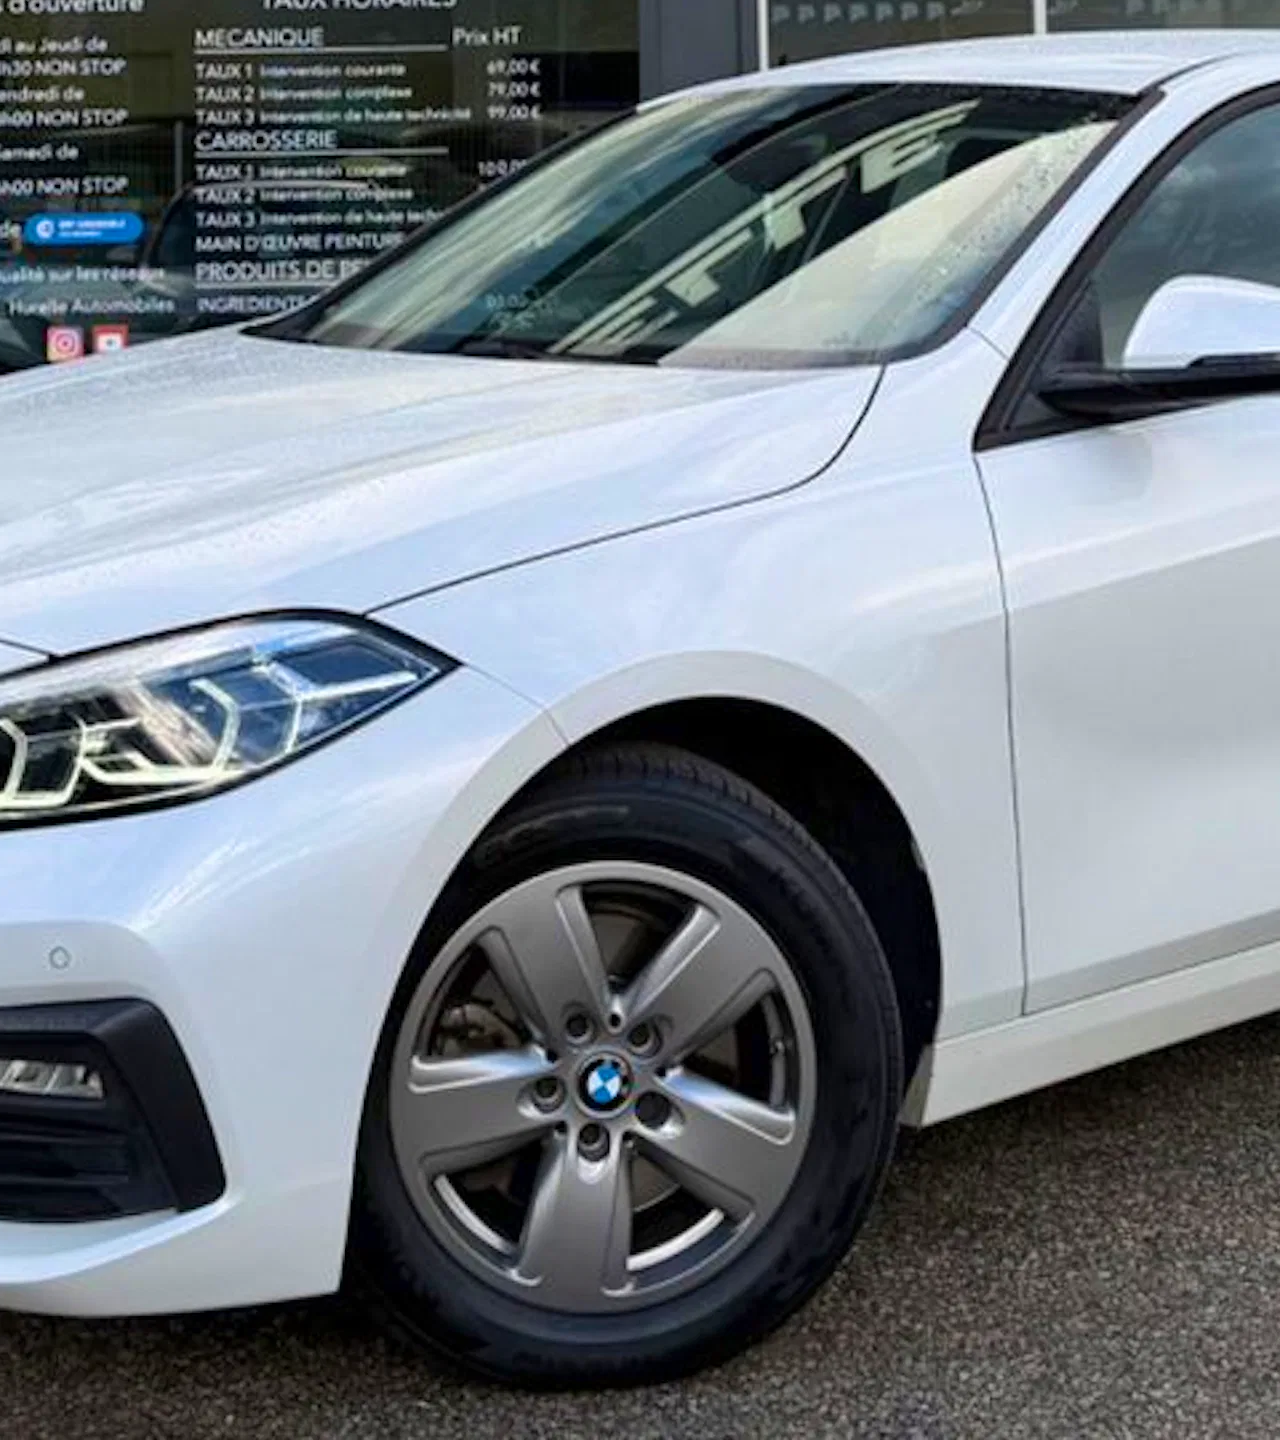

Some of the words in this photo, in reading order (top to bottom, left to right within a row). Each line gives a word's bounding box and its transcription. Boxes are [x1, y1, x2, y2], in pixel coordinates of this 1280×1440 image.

[15, 40, 35, 54] au
[85, 35, 108, 52] de
[194, 27, 324, 47] MECANIQUE
[453, 27, 489, 47] Prix
[493, 26, 523, 45] HT
[34, 58, 77, 76] NON
[79, 57, 127, 75] STOP
[195, 63, 242, 79] TAUX
[62, 85, 85, 102] de
[195, 86, 242, 103] TAUX
[243, 85, 255, 102] 2
[36, 109, 79, 127] NON
[81, 108, 129, 126] STOP
[195, 109, 242, 125] TAUX
[344, 109, 363, 122] de
[194, 129, 338, 151] CARROSSERIE
[55, 142, 79, 160] de
[195, 164, 242, 181] TAUX
[36, 177, 79, 195] NON
[82, 176, 129, 194] STOP
[195, 188, 242, 204] TAUX
[195, 211, 242, 228] TAUX
[195, 235, 242, 252] MAIN
[195, 260, 301, 281] PRODUITS
[305, 259, 334, 280] DE
